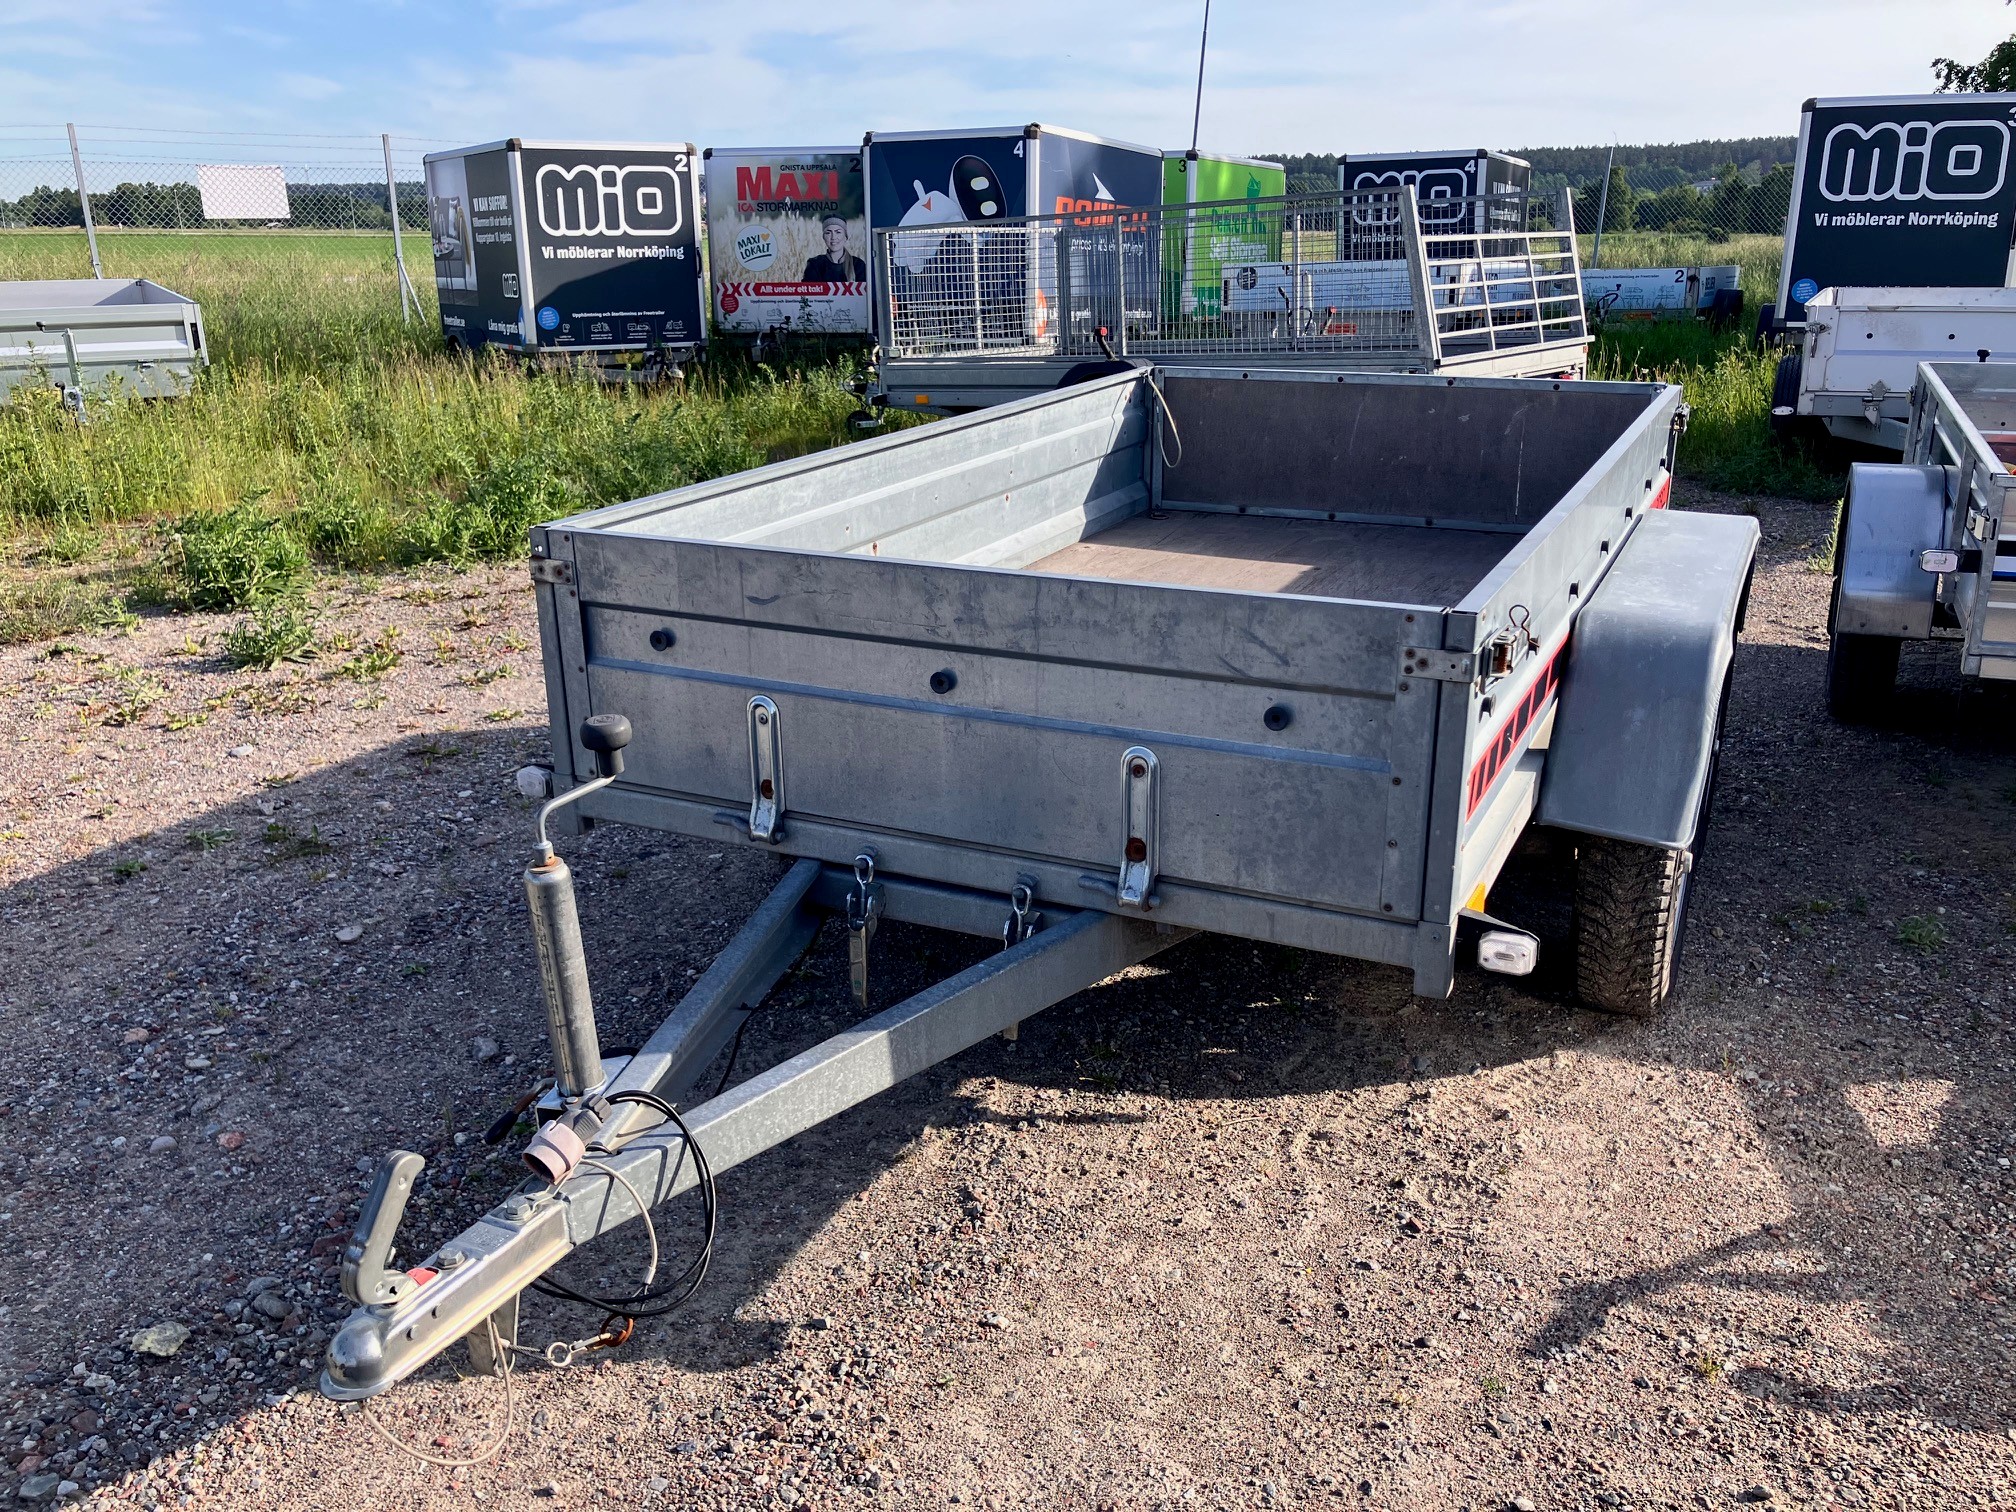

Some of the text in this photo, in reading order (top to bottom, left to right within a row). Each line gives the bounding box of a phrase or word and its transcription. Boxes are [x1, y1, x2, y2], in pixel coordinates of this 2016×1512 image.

[1013, 140, 1024, 158] 4
[674, 154, 688, 172] 2
[849, 158, 861, 173] 2
[1178, 159, 1187, 173] 3
[1464, 159, 1476, 174] 4
[757, 202, 839, 212] STORMARKNAD
[1815, 212, 1999, 228] Vi möblerar Norrköping
[737, 234, 760, 250] MAXI
[1363, 233, 1403, 243] möblera
[541, 245, 684, 260] Vi möblerar Norrköping
[740, 243, 771, 260] LOKALT
[1675, 270, 1685, 283] 2
[760, 285, 824, 293] Allt under ett tak!
